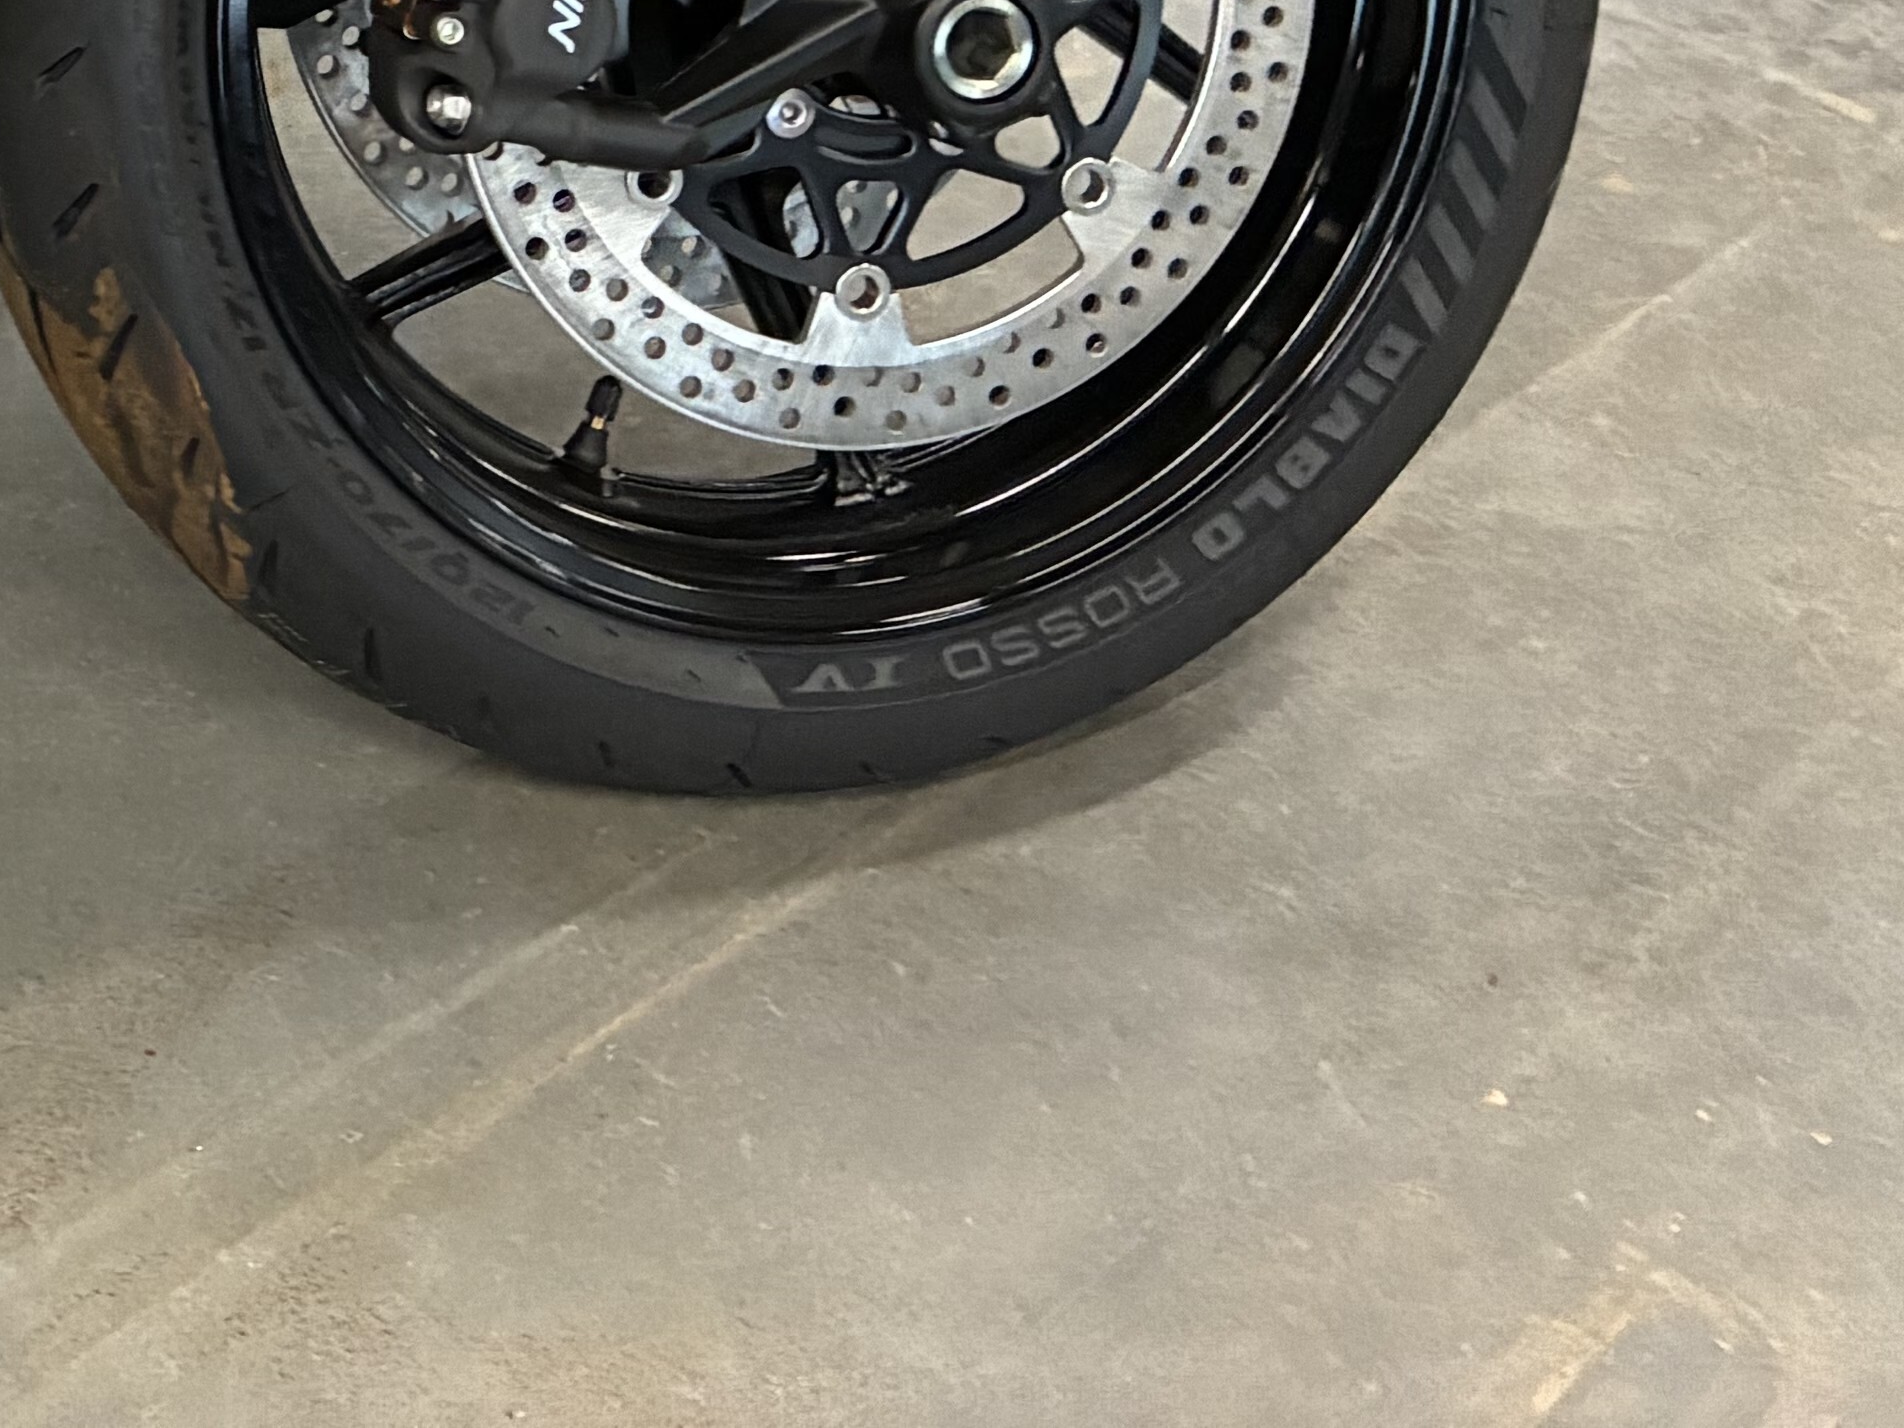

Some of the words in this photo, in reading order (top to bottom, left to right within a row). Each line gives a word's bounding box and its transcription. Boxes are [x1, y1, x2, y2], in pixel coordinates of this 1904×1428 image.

[1192, 321, 1424, 563] DIABLO
[793, 654, 912, 694] IV
[940, 555, 1186, 682] ROSSO
